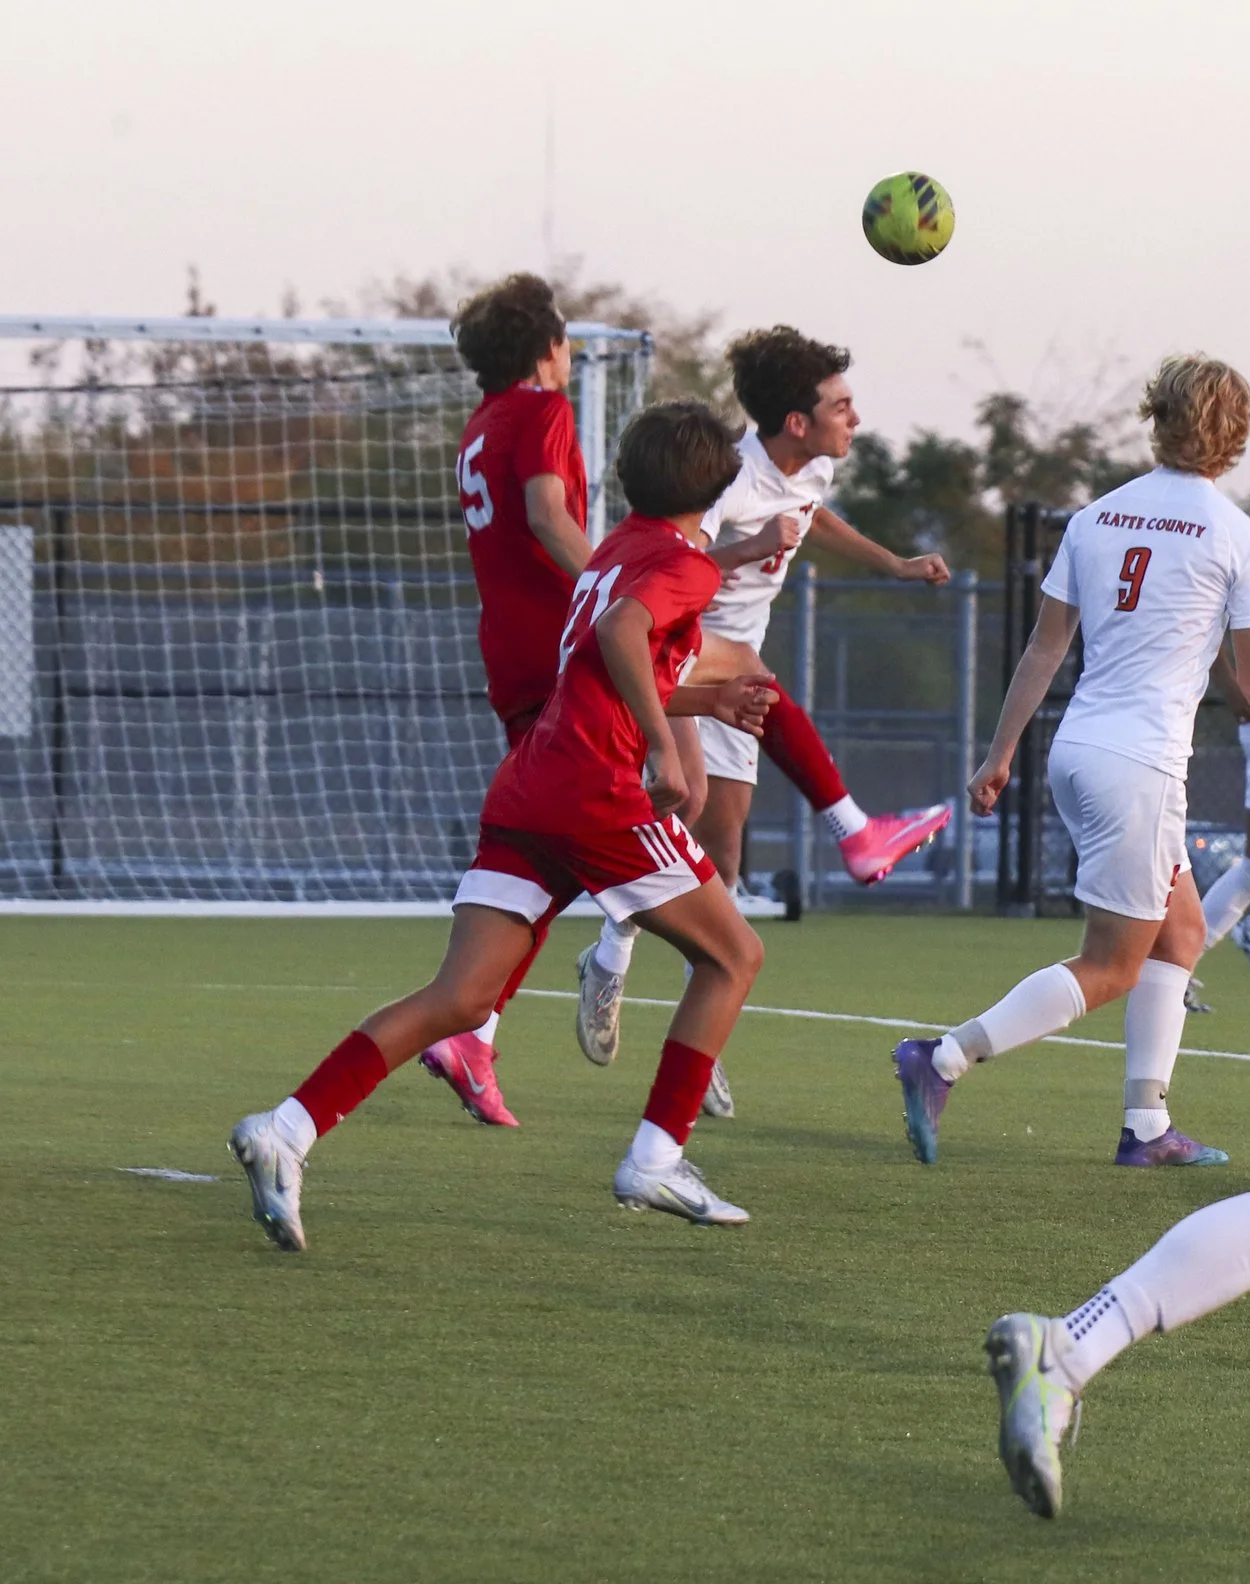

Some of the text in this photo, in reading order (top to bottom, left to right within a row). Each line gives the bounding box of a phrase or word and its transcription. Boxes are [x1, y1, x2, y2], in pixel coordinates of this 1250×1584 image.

[1096, 511, 1207, 539] PLATTE COUNTY
[1114, 546, 1153, 613] 9
